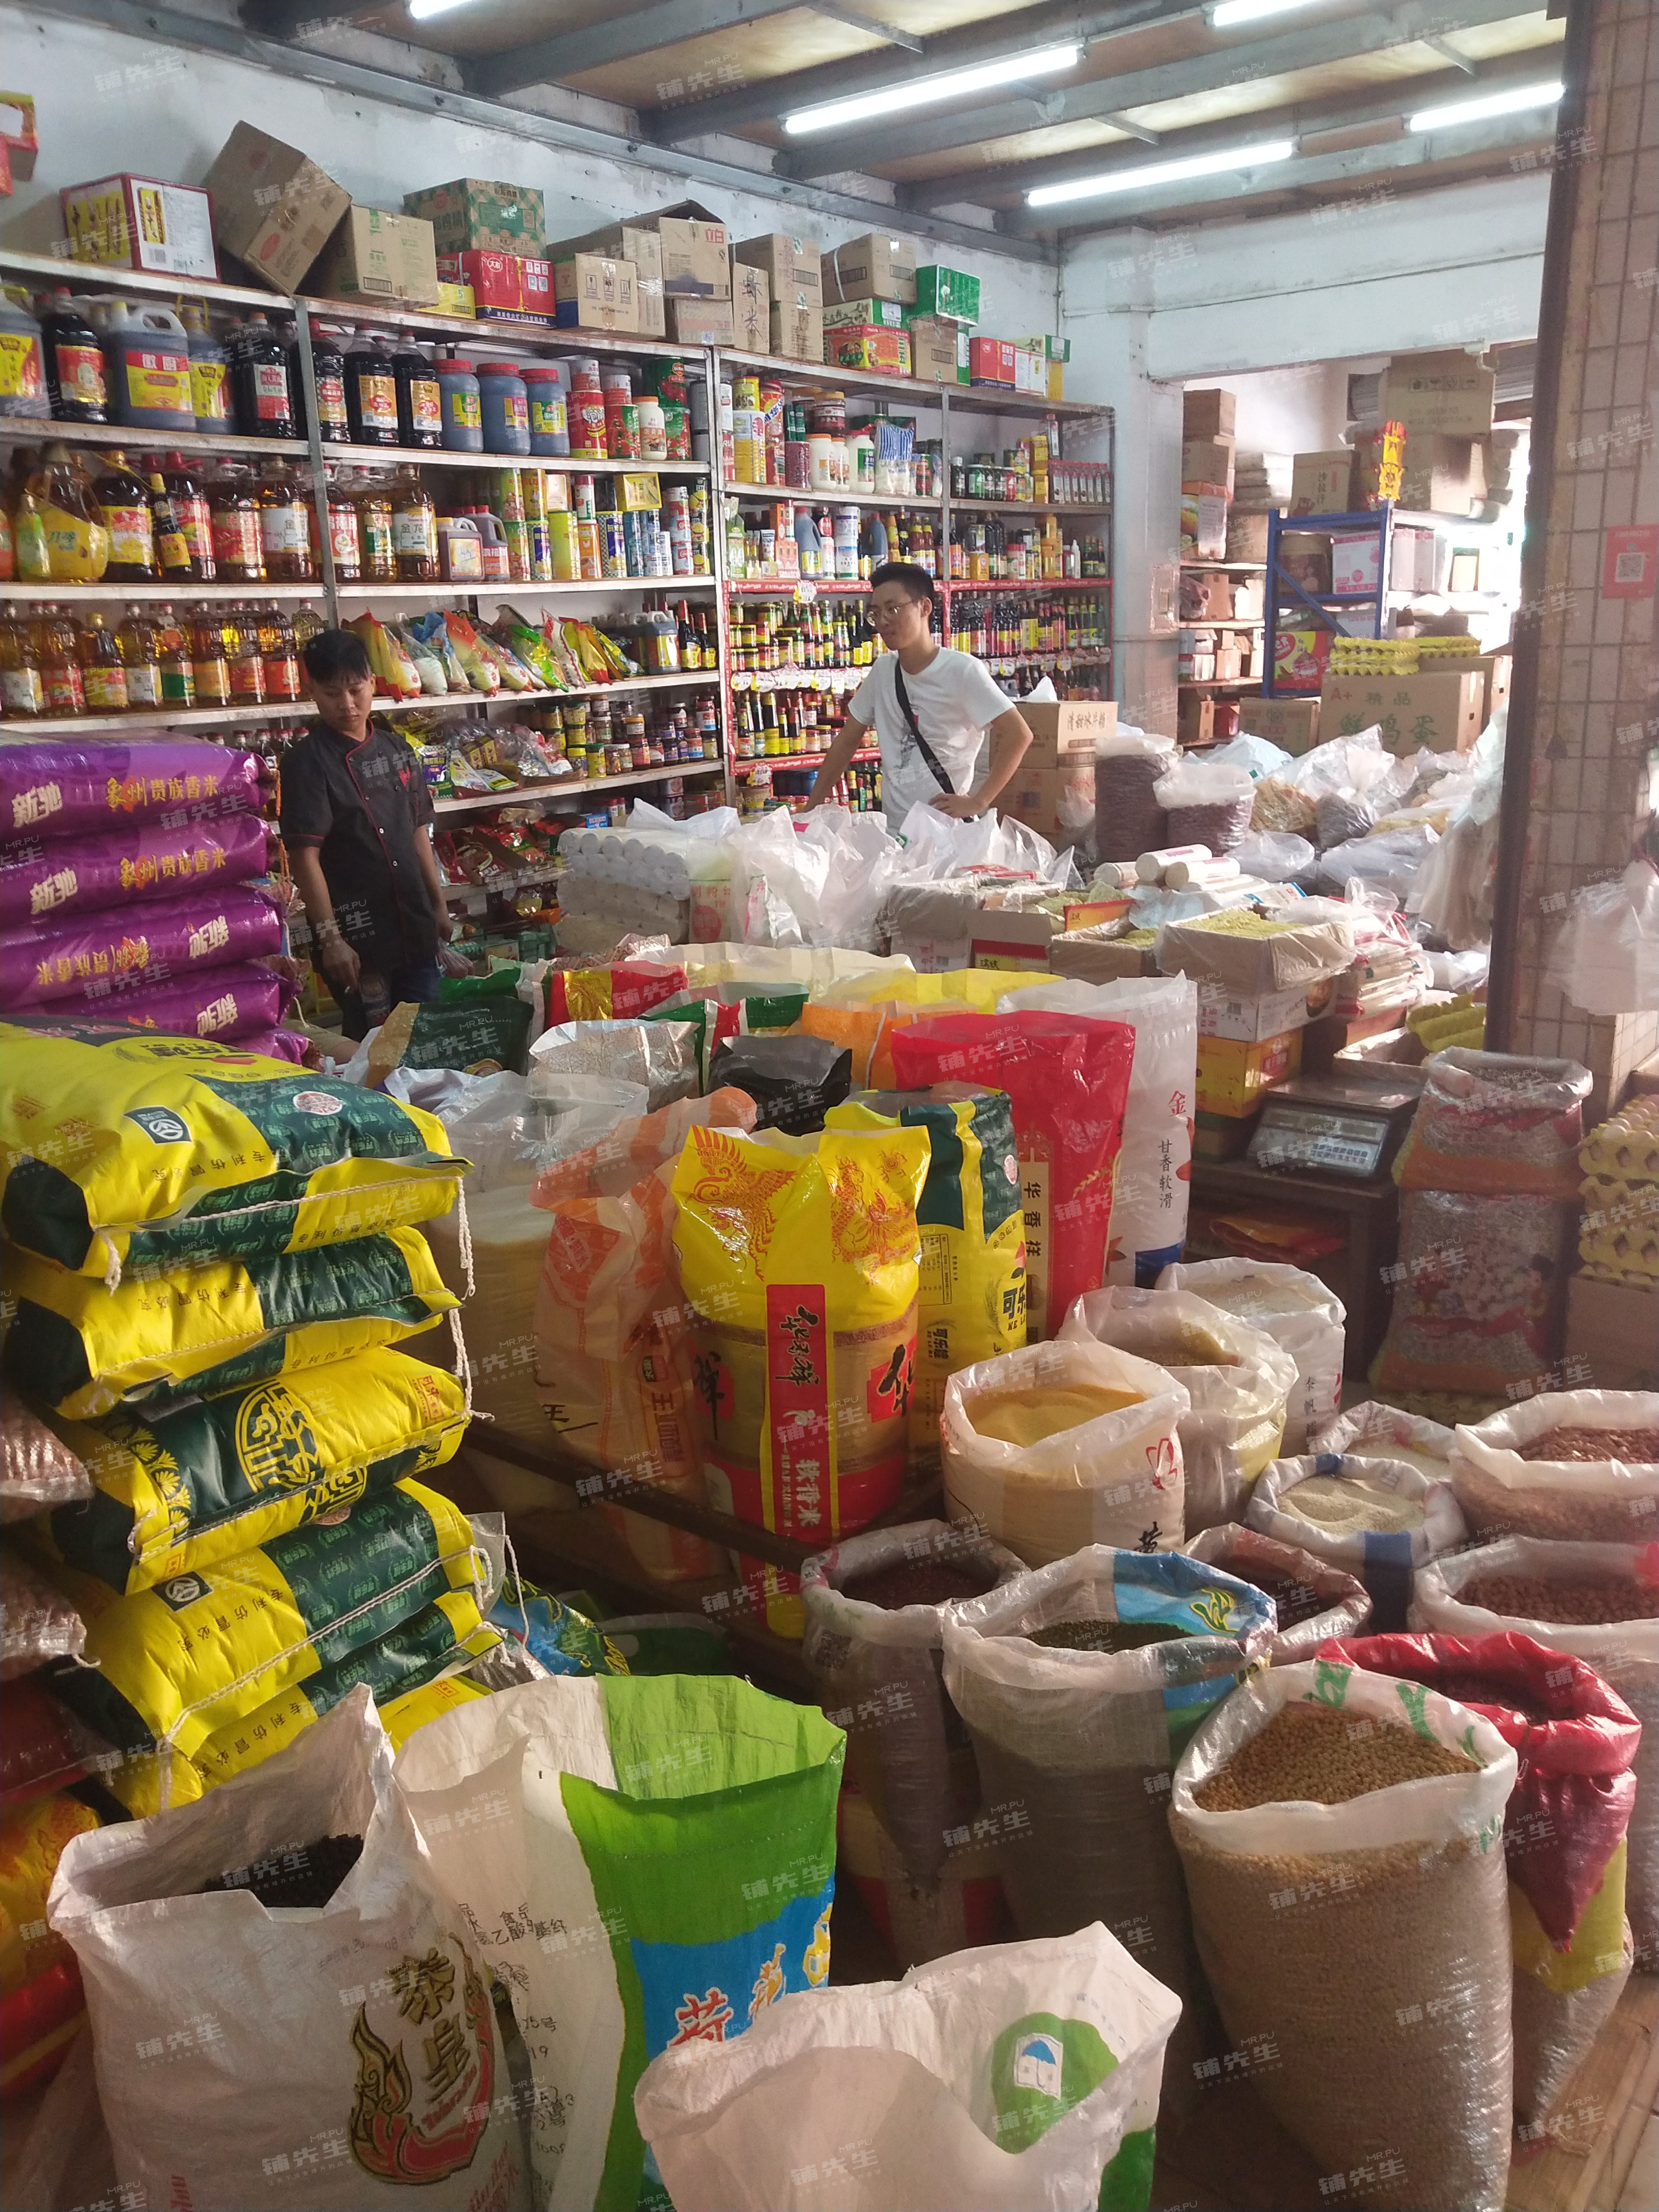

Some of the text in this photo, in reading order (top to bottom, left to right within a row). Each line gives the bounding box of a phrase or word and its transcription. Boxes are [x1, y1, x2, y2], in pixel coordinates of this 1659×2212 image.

[106, 774, 219, 811] 象州贵族香米
